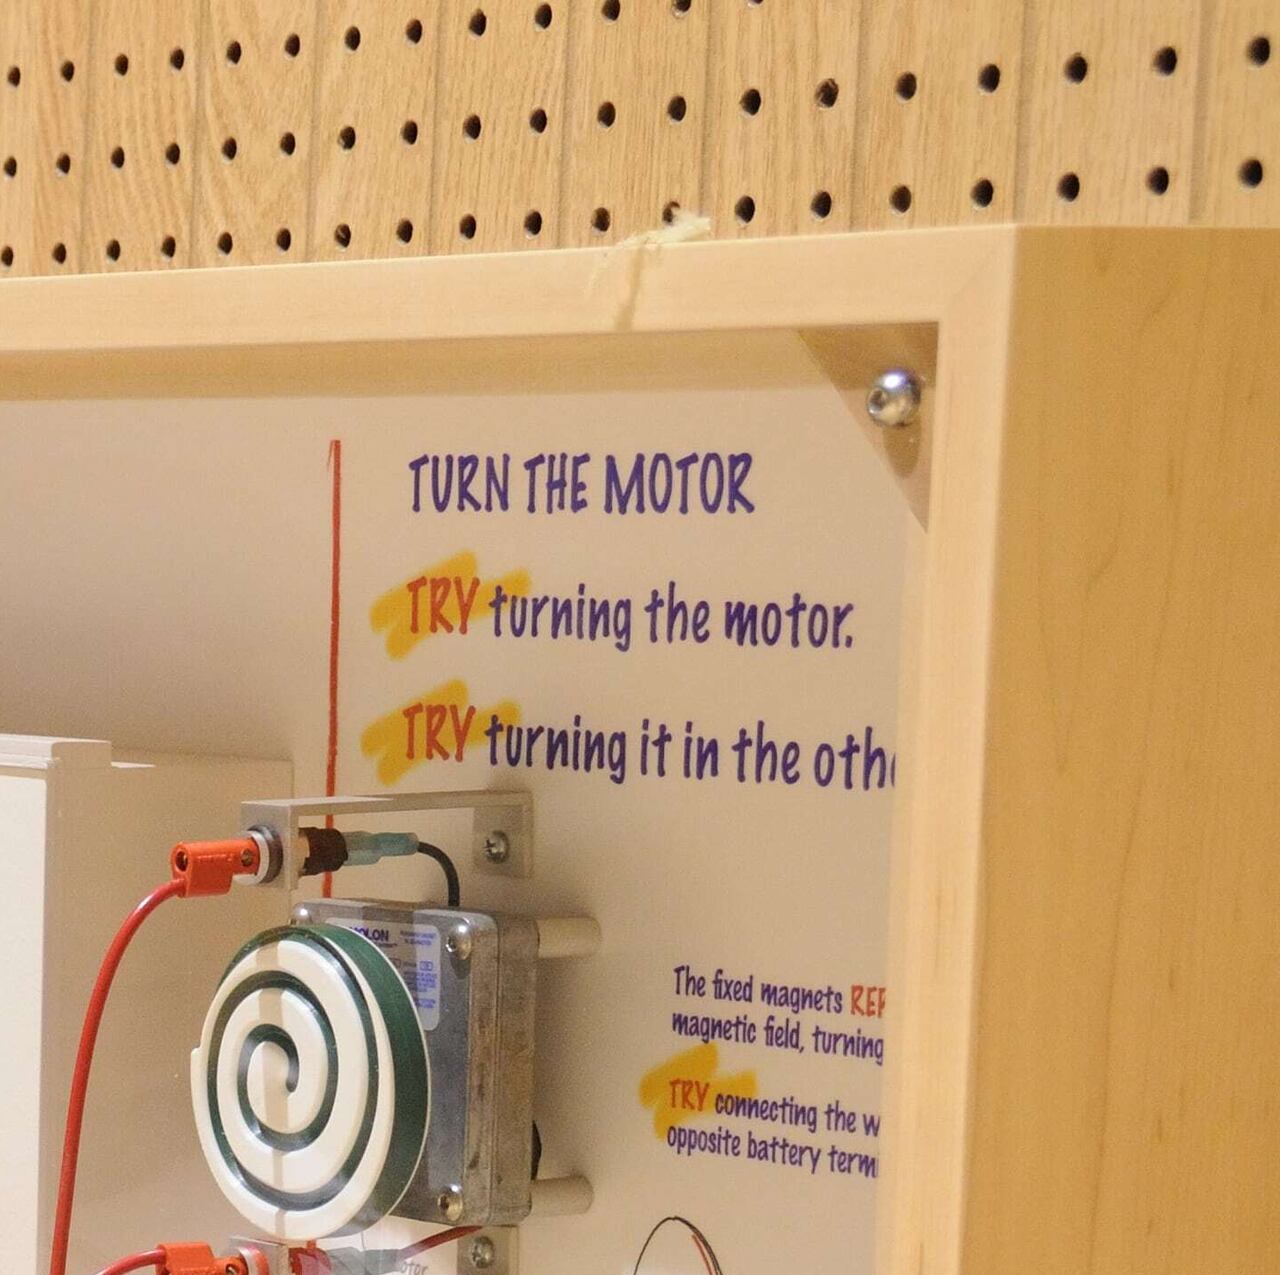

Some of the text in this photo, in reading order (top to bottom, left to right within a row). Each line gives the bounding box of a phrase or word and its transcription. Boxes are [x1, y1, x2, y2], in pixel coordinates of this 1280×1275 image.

[408, 451, 756, 515] TURN THE MOTOR
[406, 576, 854, 652] TRY turning the motor.
[402, 703, 896, 791] TRY turning it in the oth
[352, 926, 390, 942] OLON
[673, 964, 707, 998] The
[712, 968, 754, 1003] fixed
[760, 980, 843, 1015] magnets
[671, 1011, 884, 1067] magnetic field, turning
[669, 1077, 710, 1113] TRY
[714, 1091, 818, 1134] connecting
[824, 1100, 857, 1135] the
[666, 1125, 879, 1179] opposite battery term
